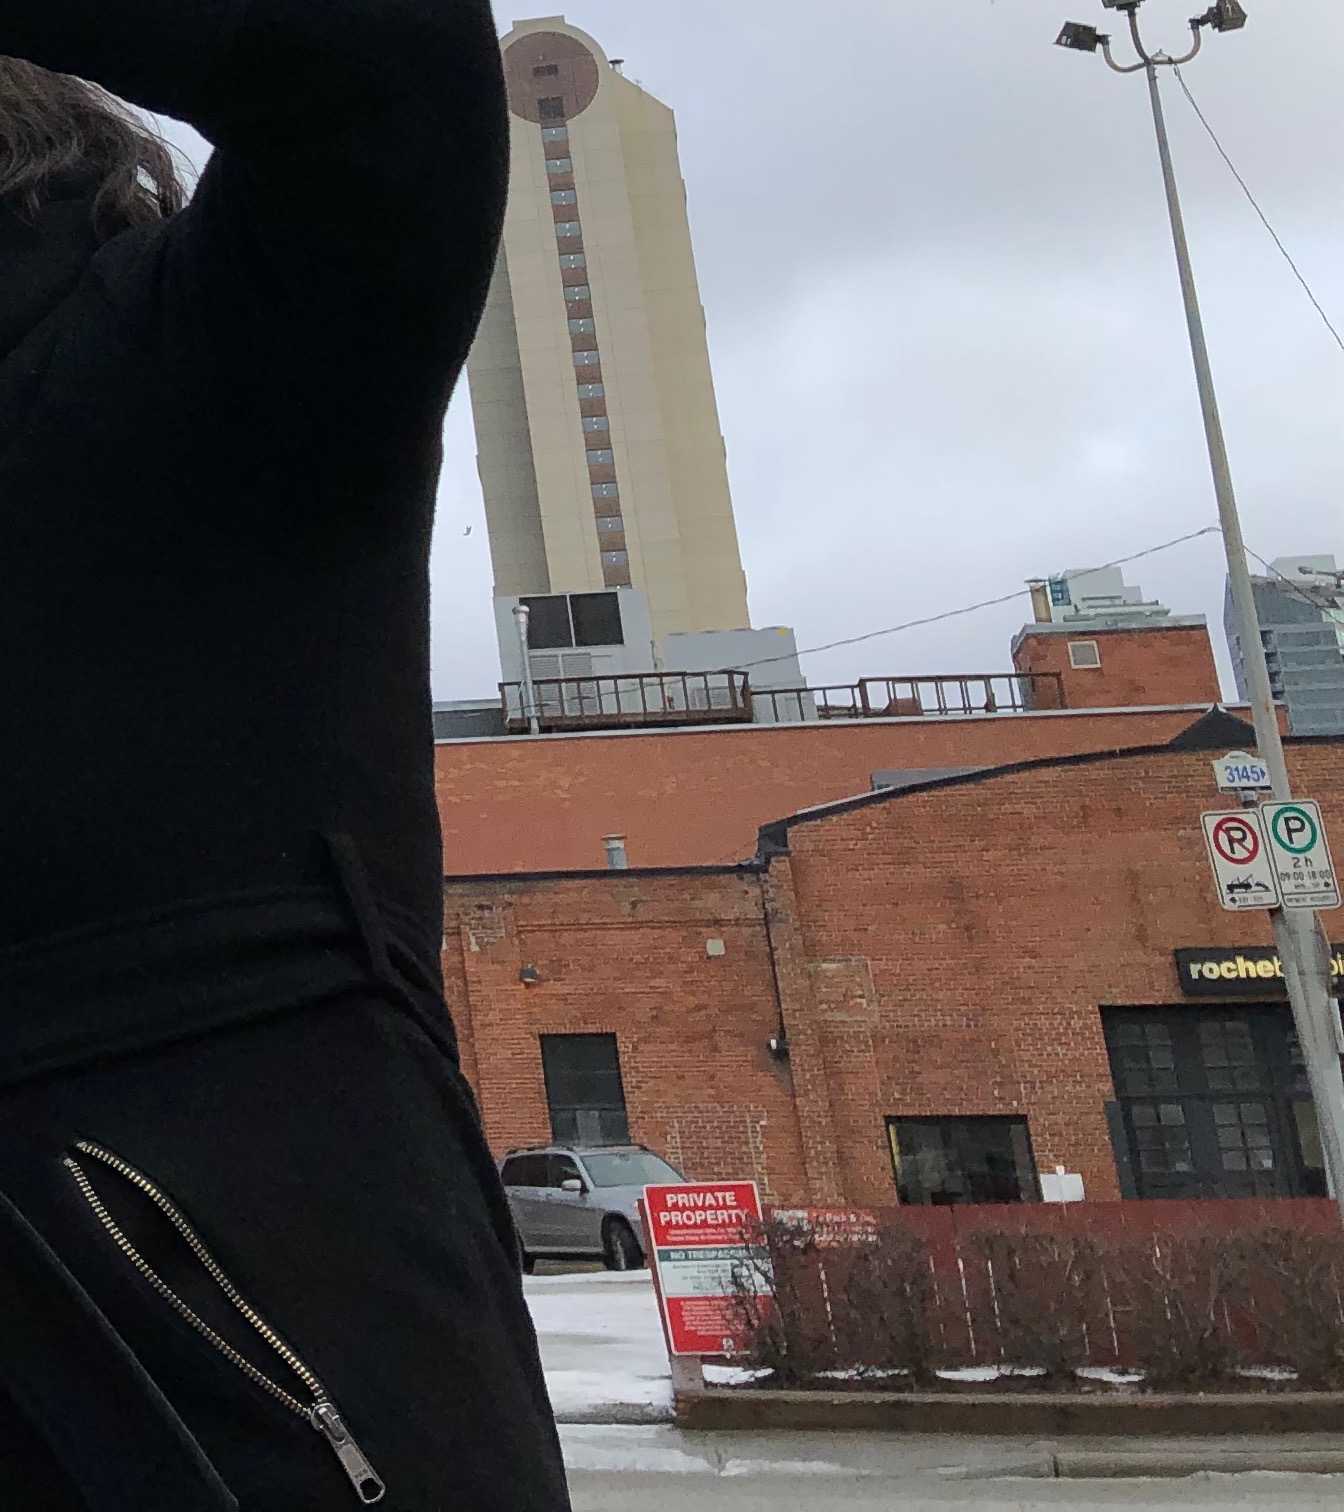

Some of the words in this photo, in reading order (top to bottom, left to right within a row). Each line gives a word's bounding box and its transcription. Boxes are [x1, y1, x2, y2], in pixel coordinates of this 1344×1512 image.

[1224, 765, 1261, 784] 3145
[1282, 815, 1306, 845] P
[1292, 856, 1302, 869] 2
[665, 1191, 738, 1208] PRIVATE
[658, 1208, 749, 1227] PROPERTY
